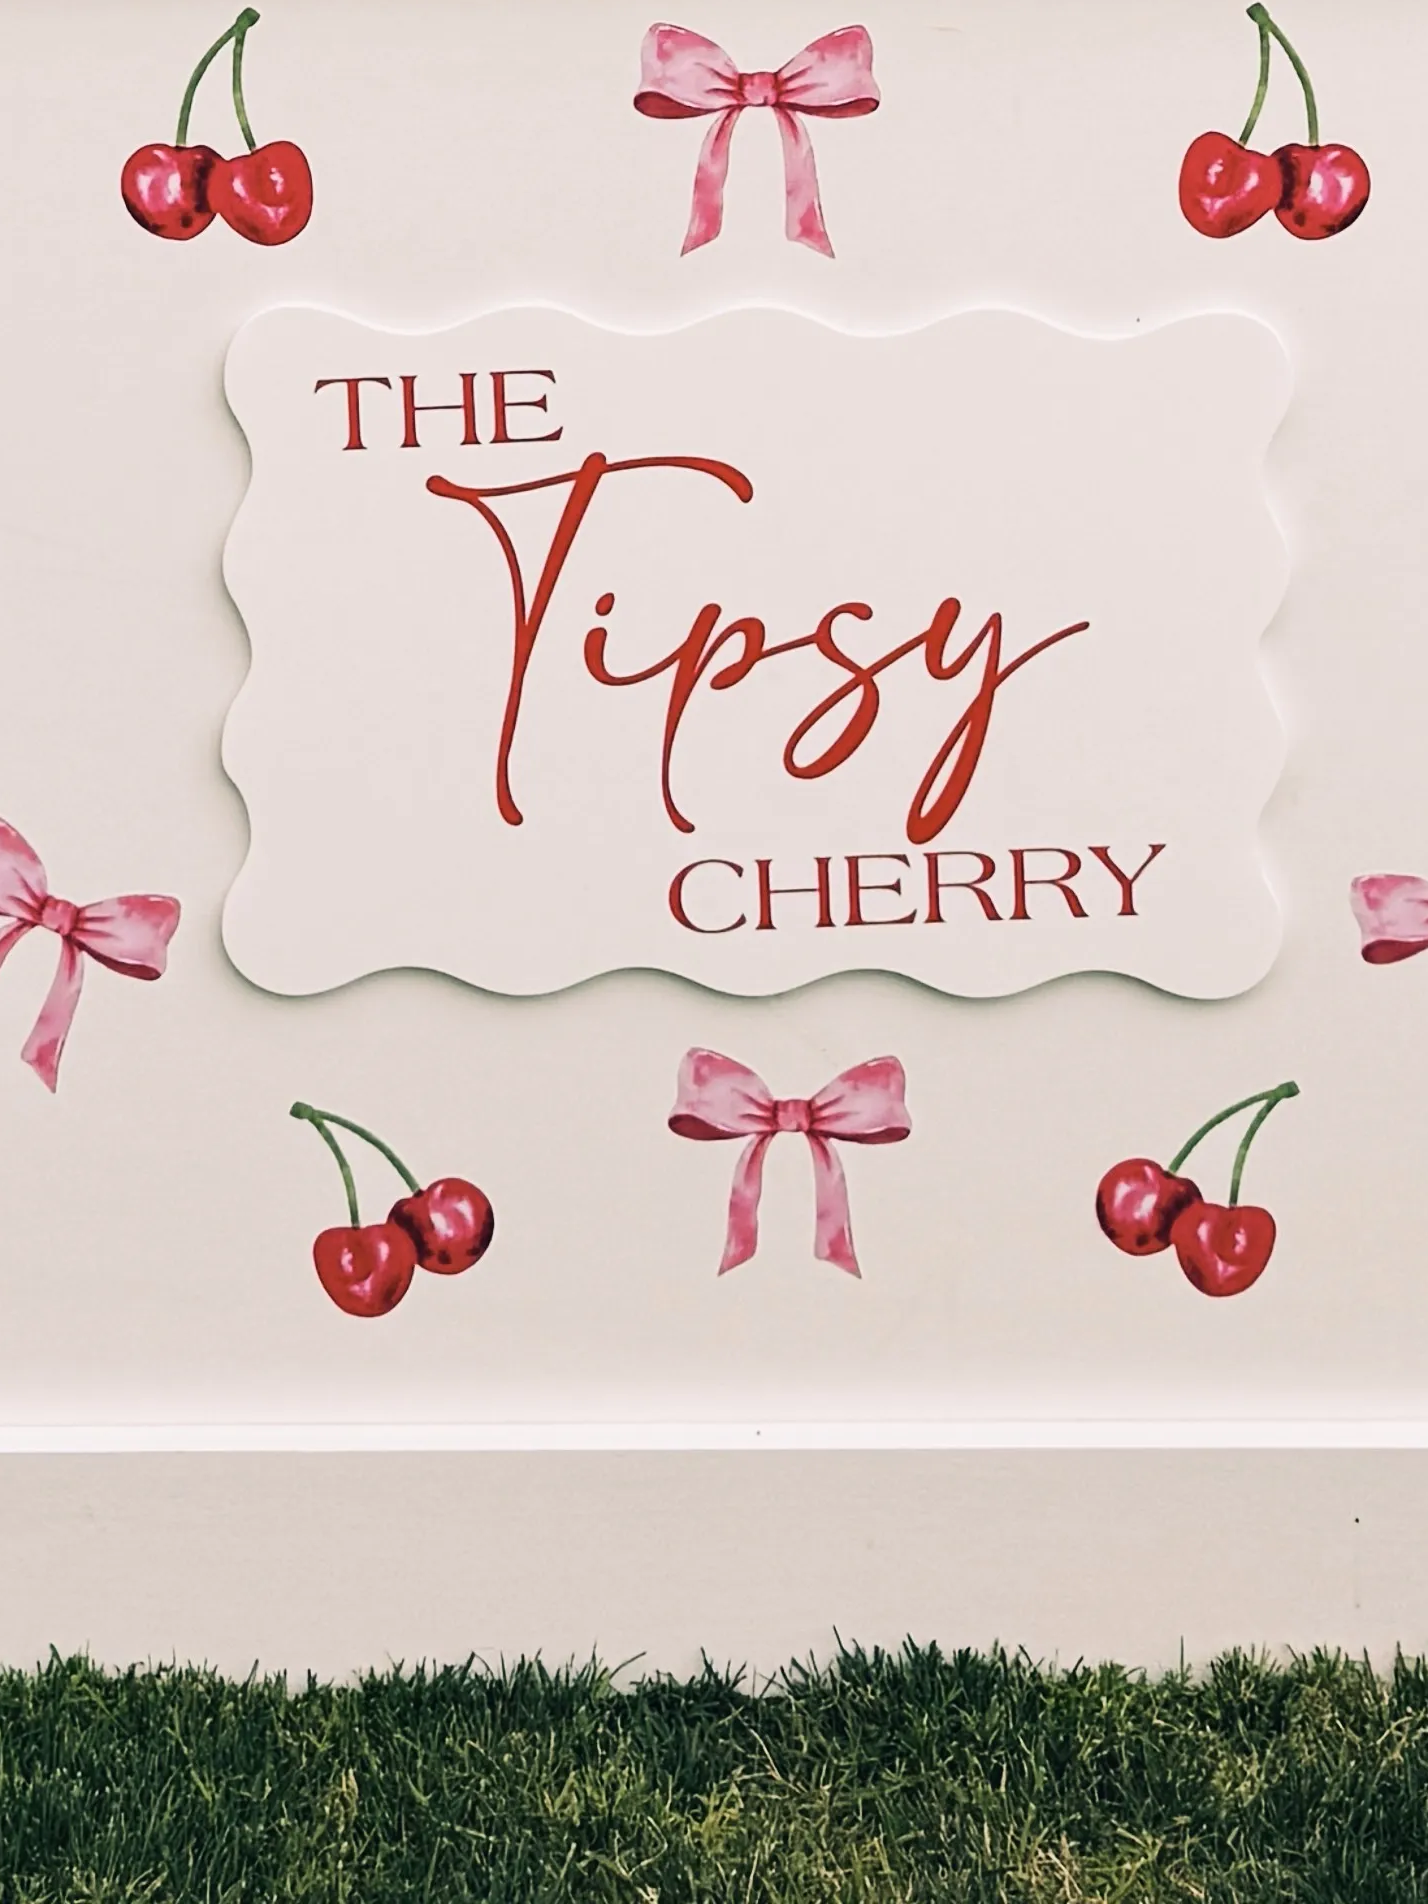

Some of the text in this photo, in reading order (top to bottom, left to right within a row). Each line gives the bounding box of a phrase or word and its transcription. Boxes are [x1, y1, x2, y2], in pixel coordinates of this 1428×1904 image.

[313, 369, 564, 452] THE
[425, 451, 1090, 845] Tipsy
[667, 842, 1167, 935] CHERRY
